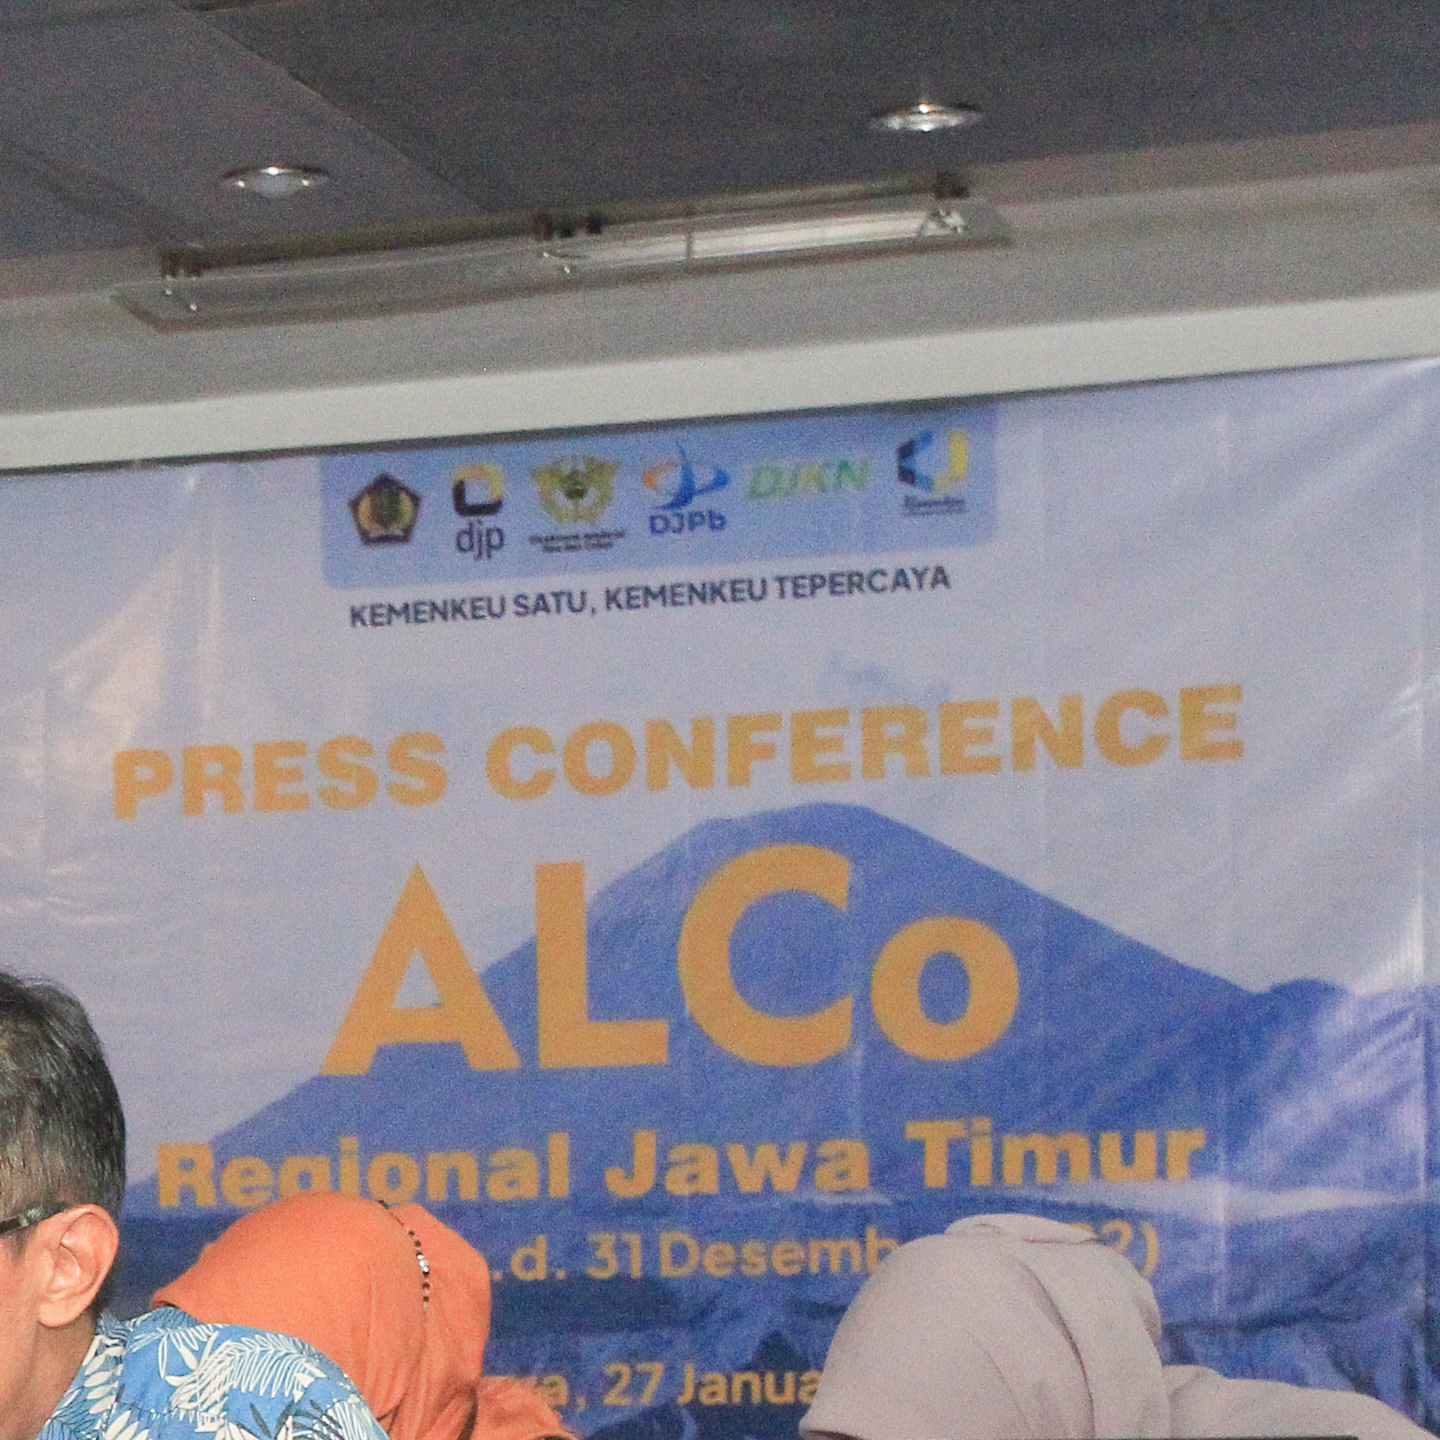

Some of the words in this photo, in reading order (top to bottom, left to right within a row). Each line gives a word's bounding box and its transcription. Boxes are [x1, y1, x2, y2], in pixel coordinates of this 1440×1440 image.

[456, 521, 504, 560] djp
[649, 508, 728, 536] DJPb
[350, 595, 506, 628] KEMENKEU
[512, 590, 598, 618] SATU,
[605, 578, 768, 613] KEMENKEU
[773, 565, 951, 599] TEPERCAYA
[113, 731, 448, 818] PRESS
[486, 683, 1245, 801] CONFERENCE
[322, 842, 1020, 1076] ALCo
[157, 1132, 569, 1207] Regional
[606, 1129, 871, 1198] Jawa
[906, 1119, 1206, 1186] Timur
[586, 1231, 642, 1279] 31
[659, 1227, 899, 1277] Desemb
[603, 1362, 666, 1406] 27
[677, 1362, 824, 1405] Janua
